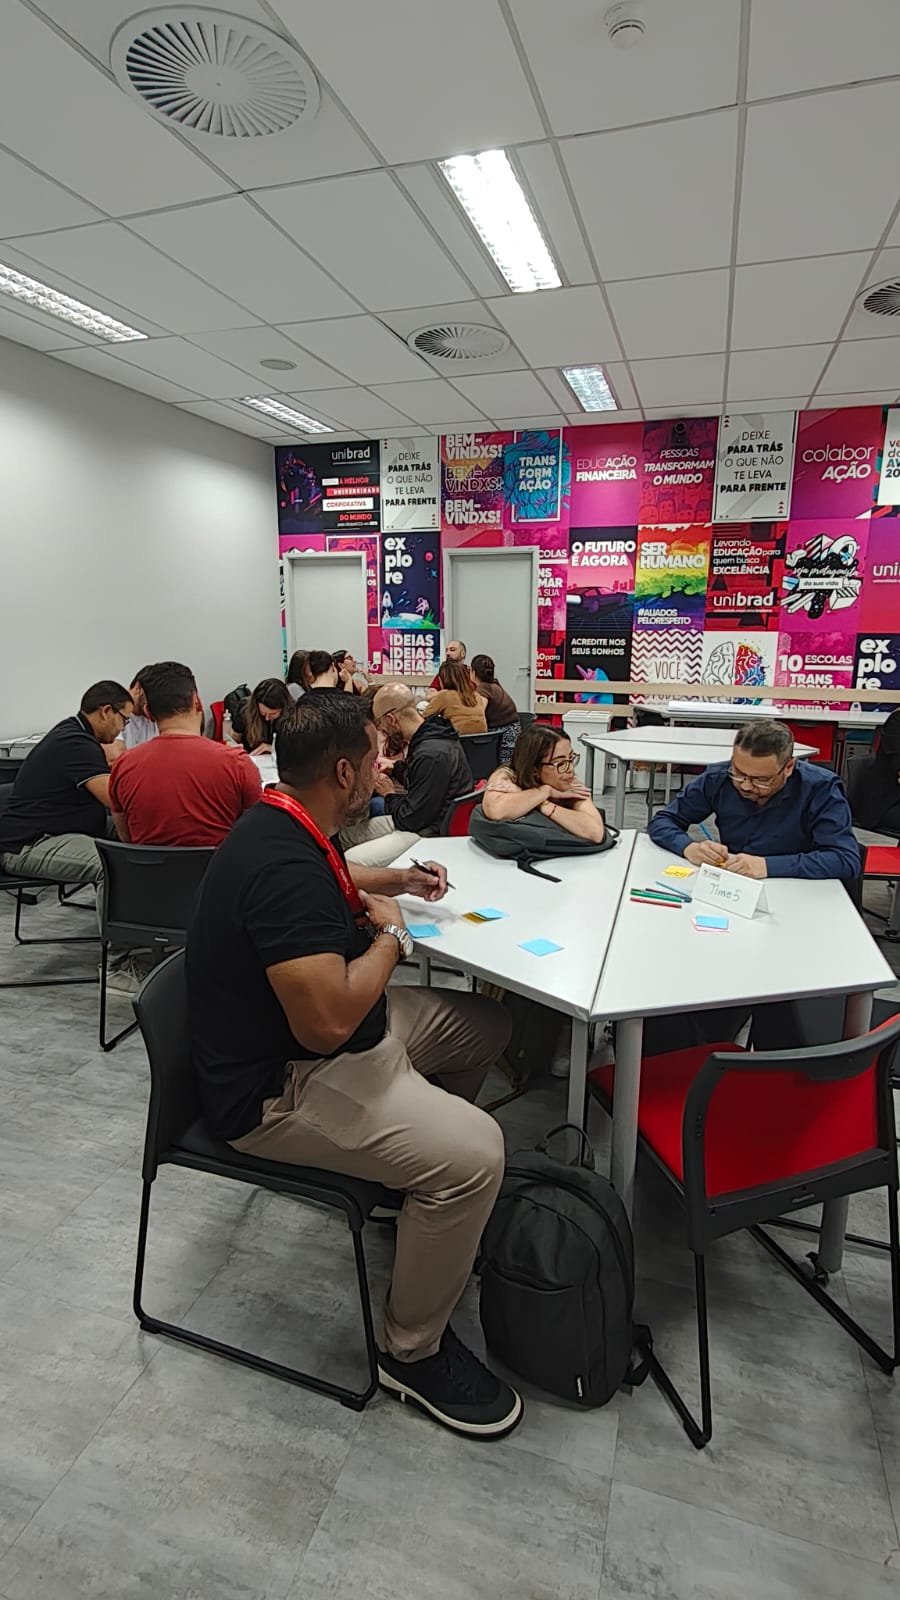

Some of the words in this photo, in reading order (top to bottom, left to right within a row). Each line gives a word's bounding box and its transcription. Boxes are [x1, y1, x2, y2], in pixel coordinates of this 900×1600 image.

[446, 433, 482, 448] BEM-
[742, 430, 770, 440] DEIXE
[332, 446, 370, 460] unibrad
[446, 445, 502, 459] VINDXS!
[660, 448, 699, 458] PESSOAS
[727, 444, 754, 455] PARA
[756, 441, 783, 453] TRÁS
[802, 444, 874, 463] colabor
[398, 452, 420, 460] DEIXE
[520, 456, 556, 466] TRANS
[576, 454, 637, 470] EDUCAÇÃO
[724, 458, 734, 468] O
[736, 456, 758, 467] QUE
[761, 454, 784, 465] NÃO
[388, 464, 408, 472] PARA
[410, 462, 431, 470] TRÁS
[644, 460, 714, 472] TRANSFORMAM
[822, 462, 871, 483] AÇÃO
[386, 476, 394, 484] O
[396, 475, 413, 484] QUE
[415, 473, 432, 482] NÃO
[520, 468, 552, 478] FORM
[576, 470, 637, 482] FINANCEIRA
[653, 475, 663, 486] O
[663, 473, 703, 485] MUNDO
[734, 471, 745, 480] TE
[748, 470, 772, 479] LEVA
[406, 486, 424, 494] LEVA
[519, 478, 552, 492] AÇÃO
[720, 483, 746, 493] PARA
[749, 482, 787, 492] FRENTE
[386, 498, 406, 506] PARA
[408, 497, 436, 505] FRENTE
[444, 499, 480, 512] BEM-
[444, 510, 501, 524] VINDXS!
[384, 536, 406, 551] ex
[572, 542, 584, 553] O
[584, 540, 636, 553] FUTURO
[640, 542, 667, 556] SER
[714, 538, 752, 547] Levando
[713, 546, 762, 557] EDUCAÇÃO
[384, 550, 412, 571] plo
[572, 552, 580, 566] É
[580, 554, 628, 566] AGORA
[640, 554, 705, 569] HUMANO
[713, 564, 770, 574] EXCELÊNCIA
[873, 562, 900, 576] uni
[384, 570, 403, 584] re
[713, 592, 774, 606] unibrad
[638, 609, 678, 617] #ALIADOS
[390, 634, 434, 646] IDEIAS
[571, 638, 608, 646] ACREDITE
[608, 638, 626, 646] NOS
[860, 638, 891, 654] ex
[390, 647, 434, 660] IDEIAS
[591, 648, 625, 656] SONHOS
[390, 660, 434, 672] IDEIAS
[655, 656, 680, 680] VOCÊ
[779, 655, 803, 672] 10
[805, 655, 853, 664] ESCOLAS
[858, 653, 896, 677] plo
[790, 674, 833, 684] TRANS
[856, 678, 882, 690] re
[710, 882, 732, 898] Time
